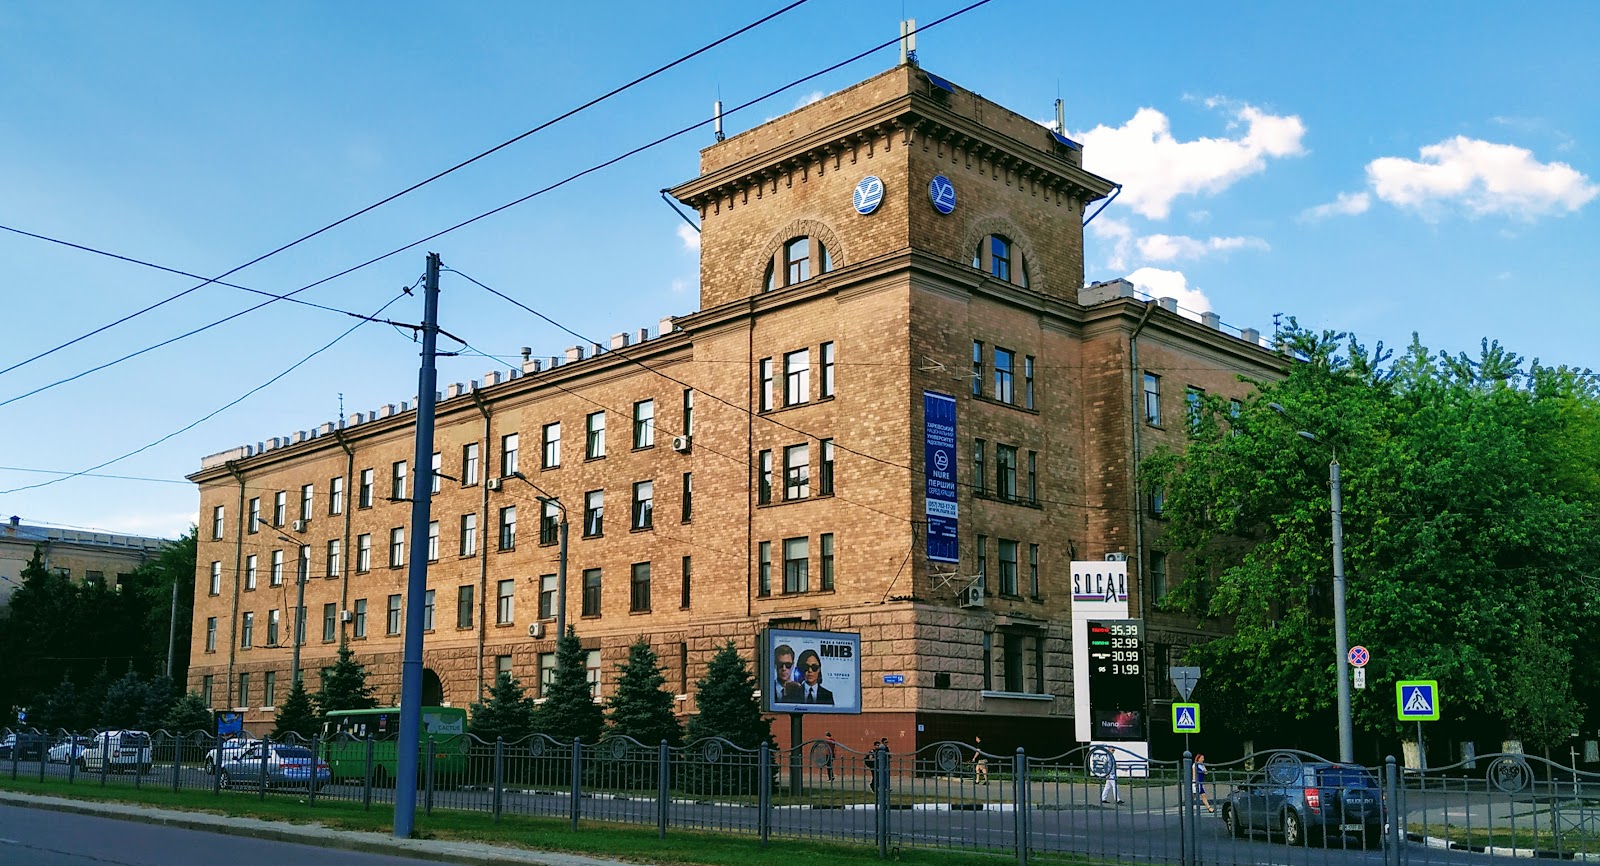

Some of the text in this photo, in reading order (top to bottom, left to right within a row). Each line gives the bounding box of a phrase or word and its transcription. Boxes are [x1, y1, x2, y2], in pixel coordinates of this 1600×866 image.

[933, 469, 950, 480] NURE
[928, 479, 955, 490] ПЕРШИЙ
[1073, 572, 1125, 603] SOCAR
[1111, 625, 1138, 636] 35.39
[1111, 638, 1138, 649] 32.99
[820, 645, 853, 658] MIB
[1112, 651, 1139, 662] 30.99
[1112, 664, 1139, 675] 31.99
[1101, 720, 1120, 728] Nano
